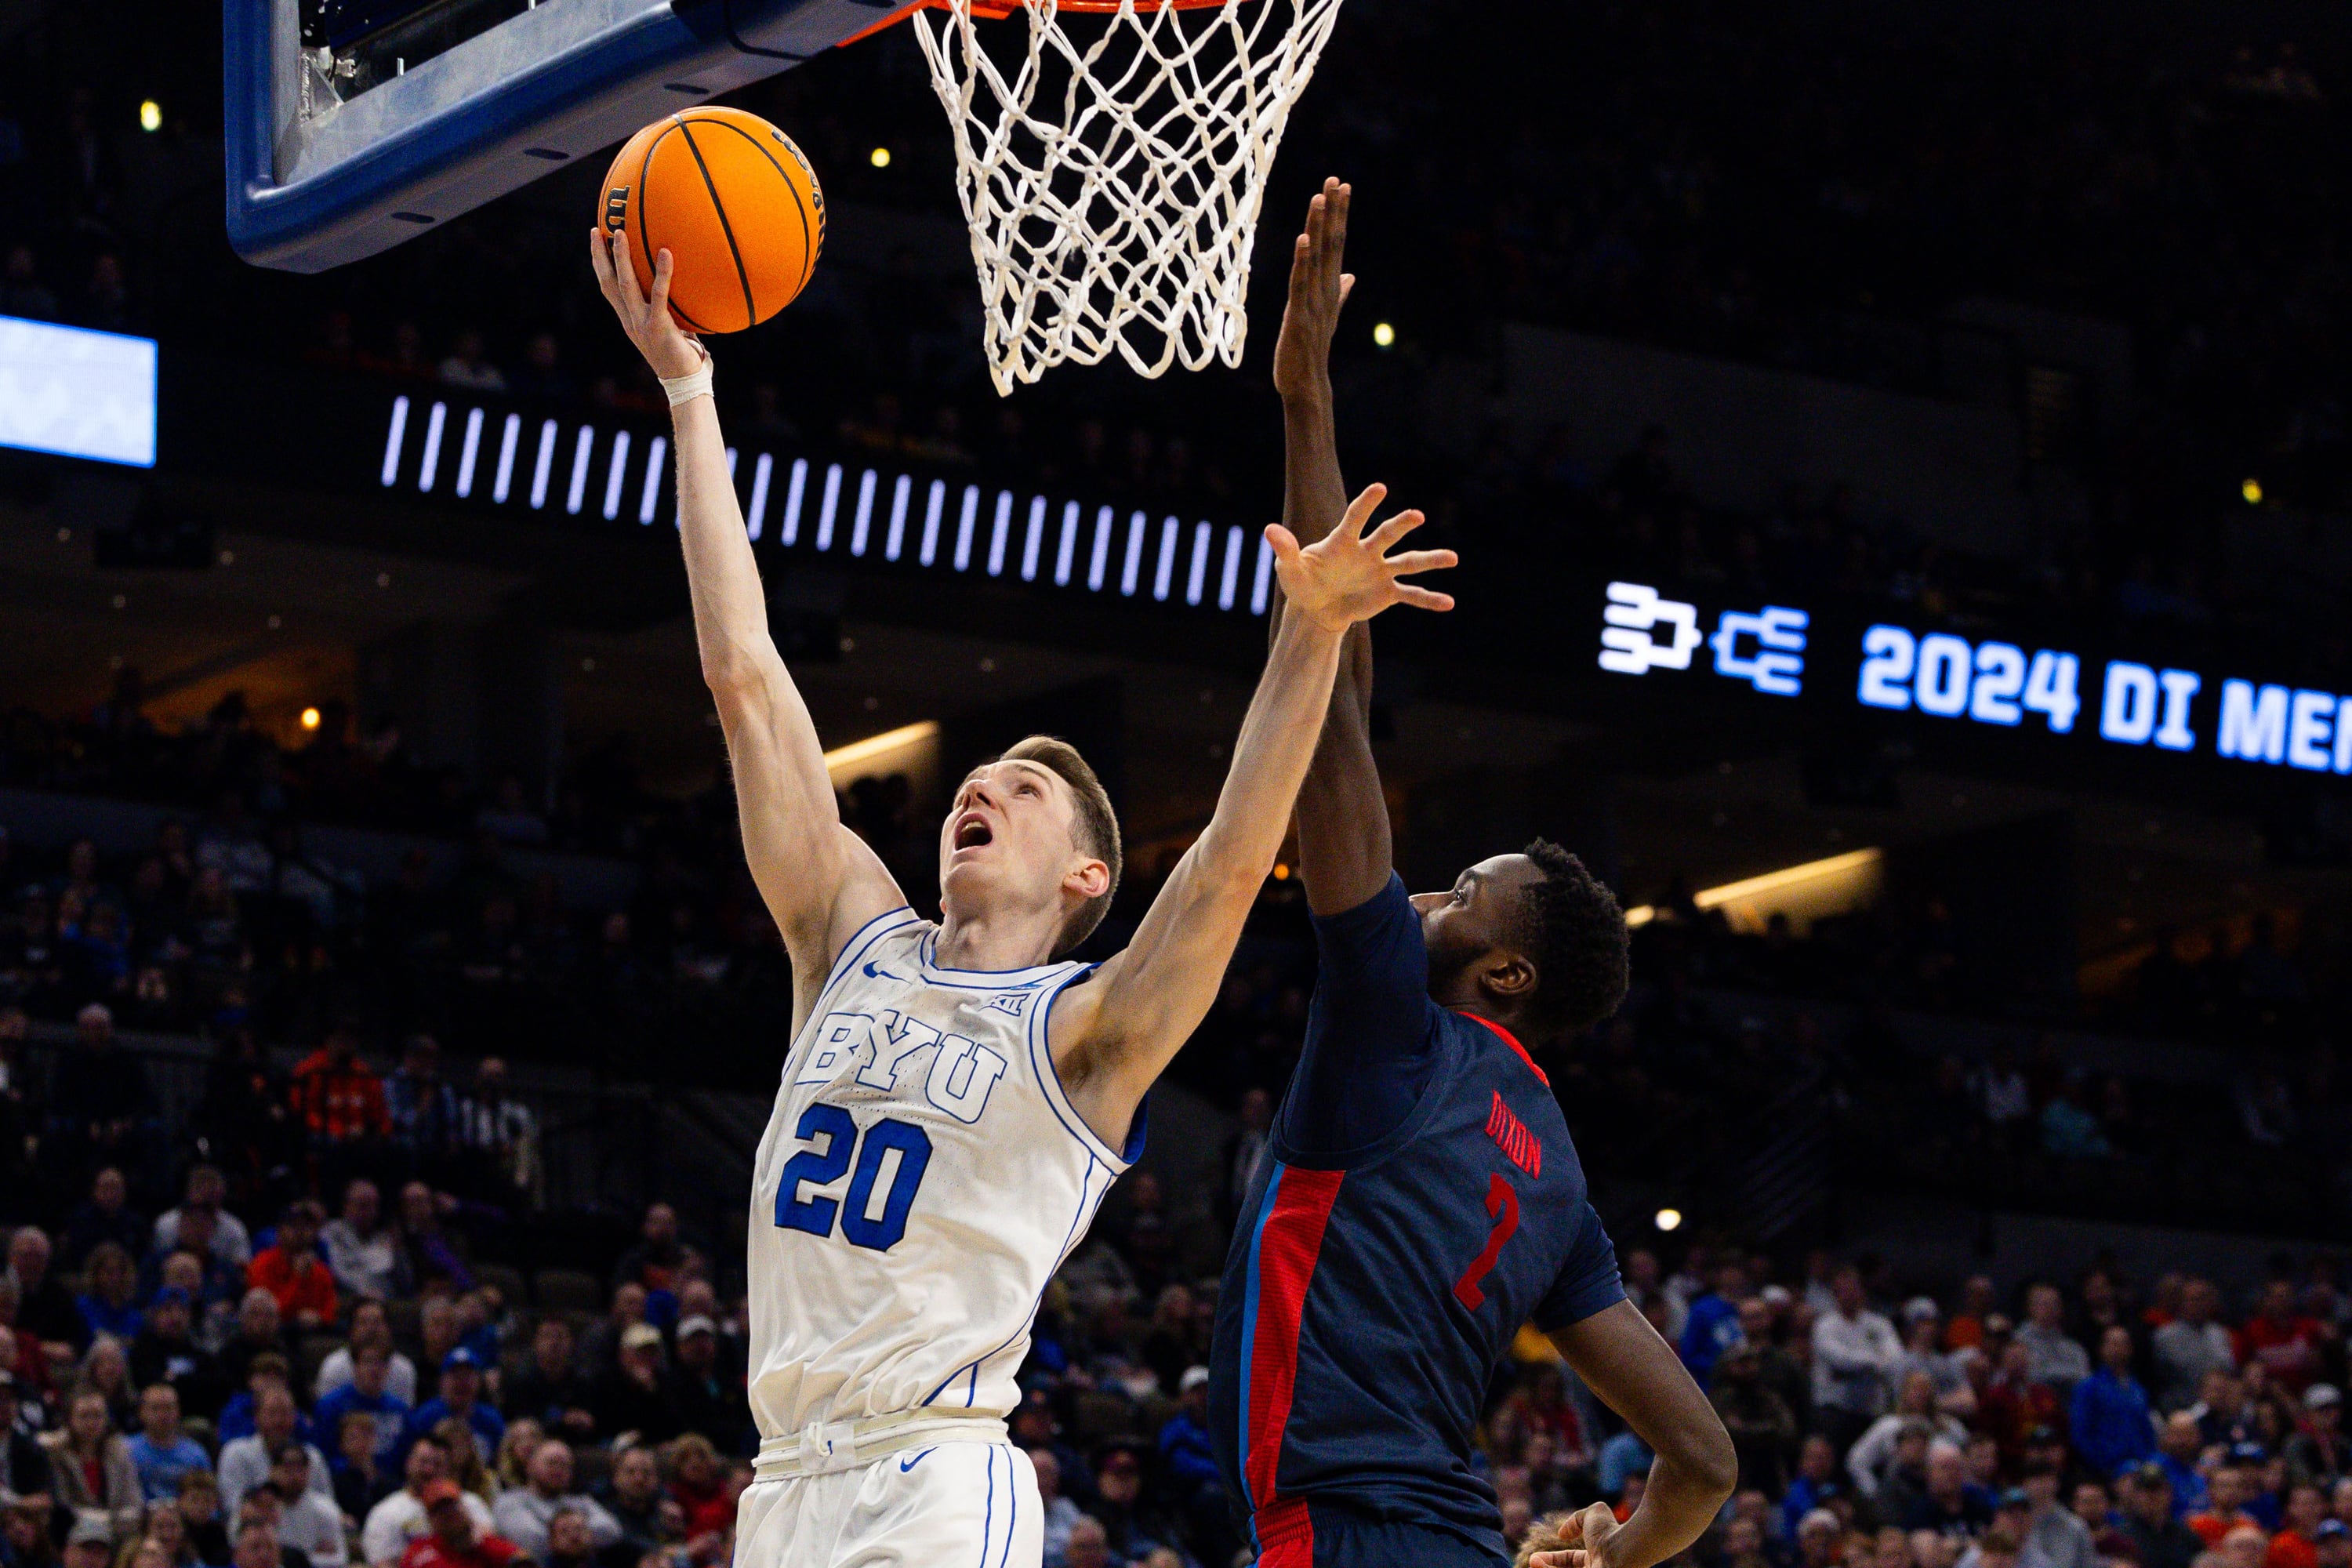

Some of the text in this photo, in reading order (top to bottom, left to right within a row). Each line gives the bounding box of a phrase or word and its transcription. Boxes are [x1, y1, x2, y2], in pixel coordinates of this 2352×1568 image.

[1857, 624, 2352, 775] 2024 DI ME
[794, 1010, 1008, 1124] BYU
[1485, 1090, 1542, 1181] DIXON
[775, 1102, 933, 1253] 20
[1454, 1172, 1519, 1312] 2
